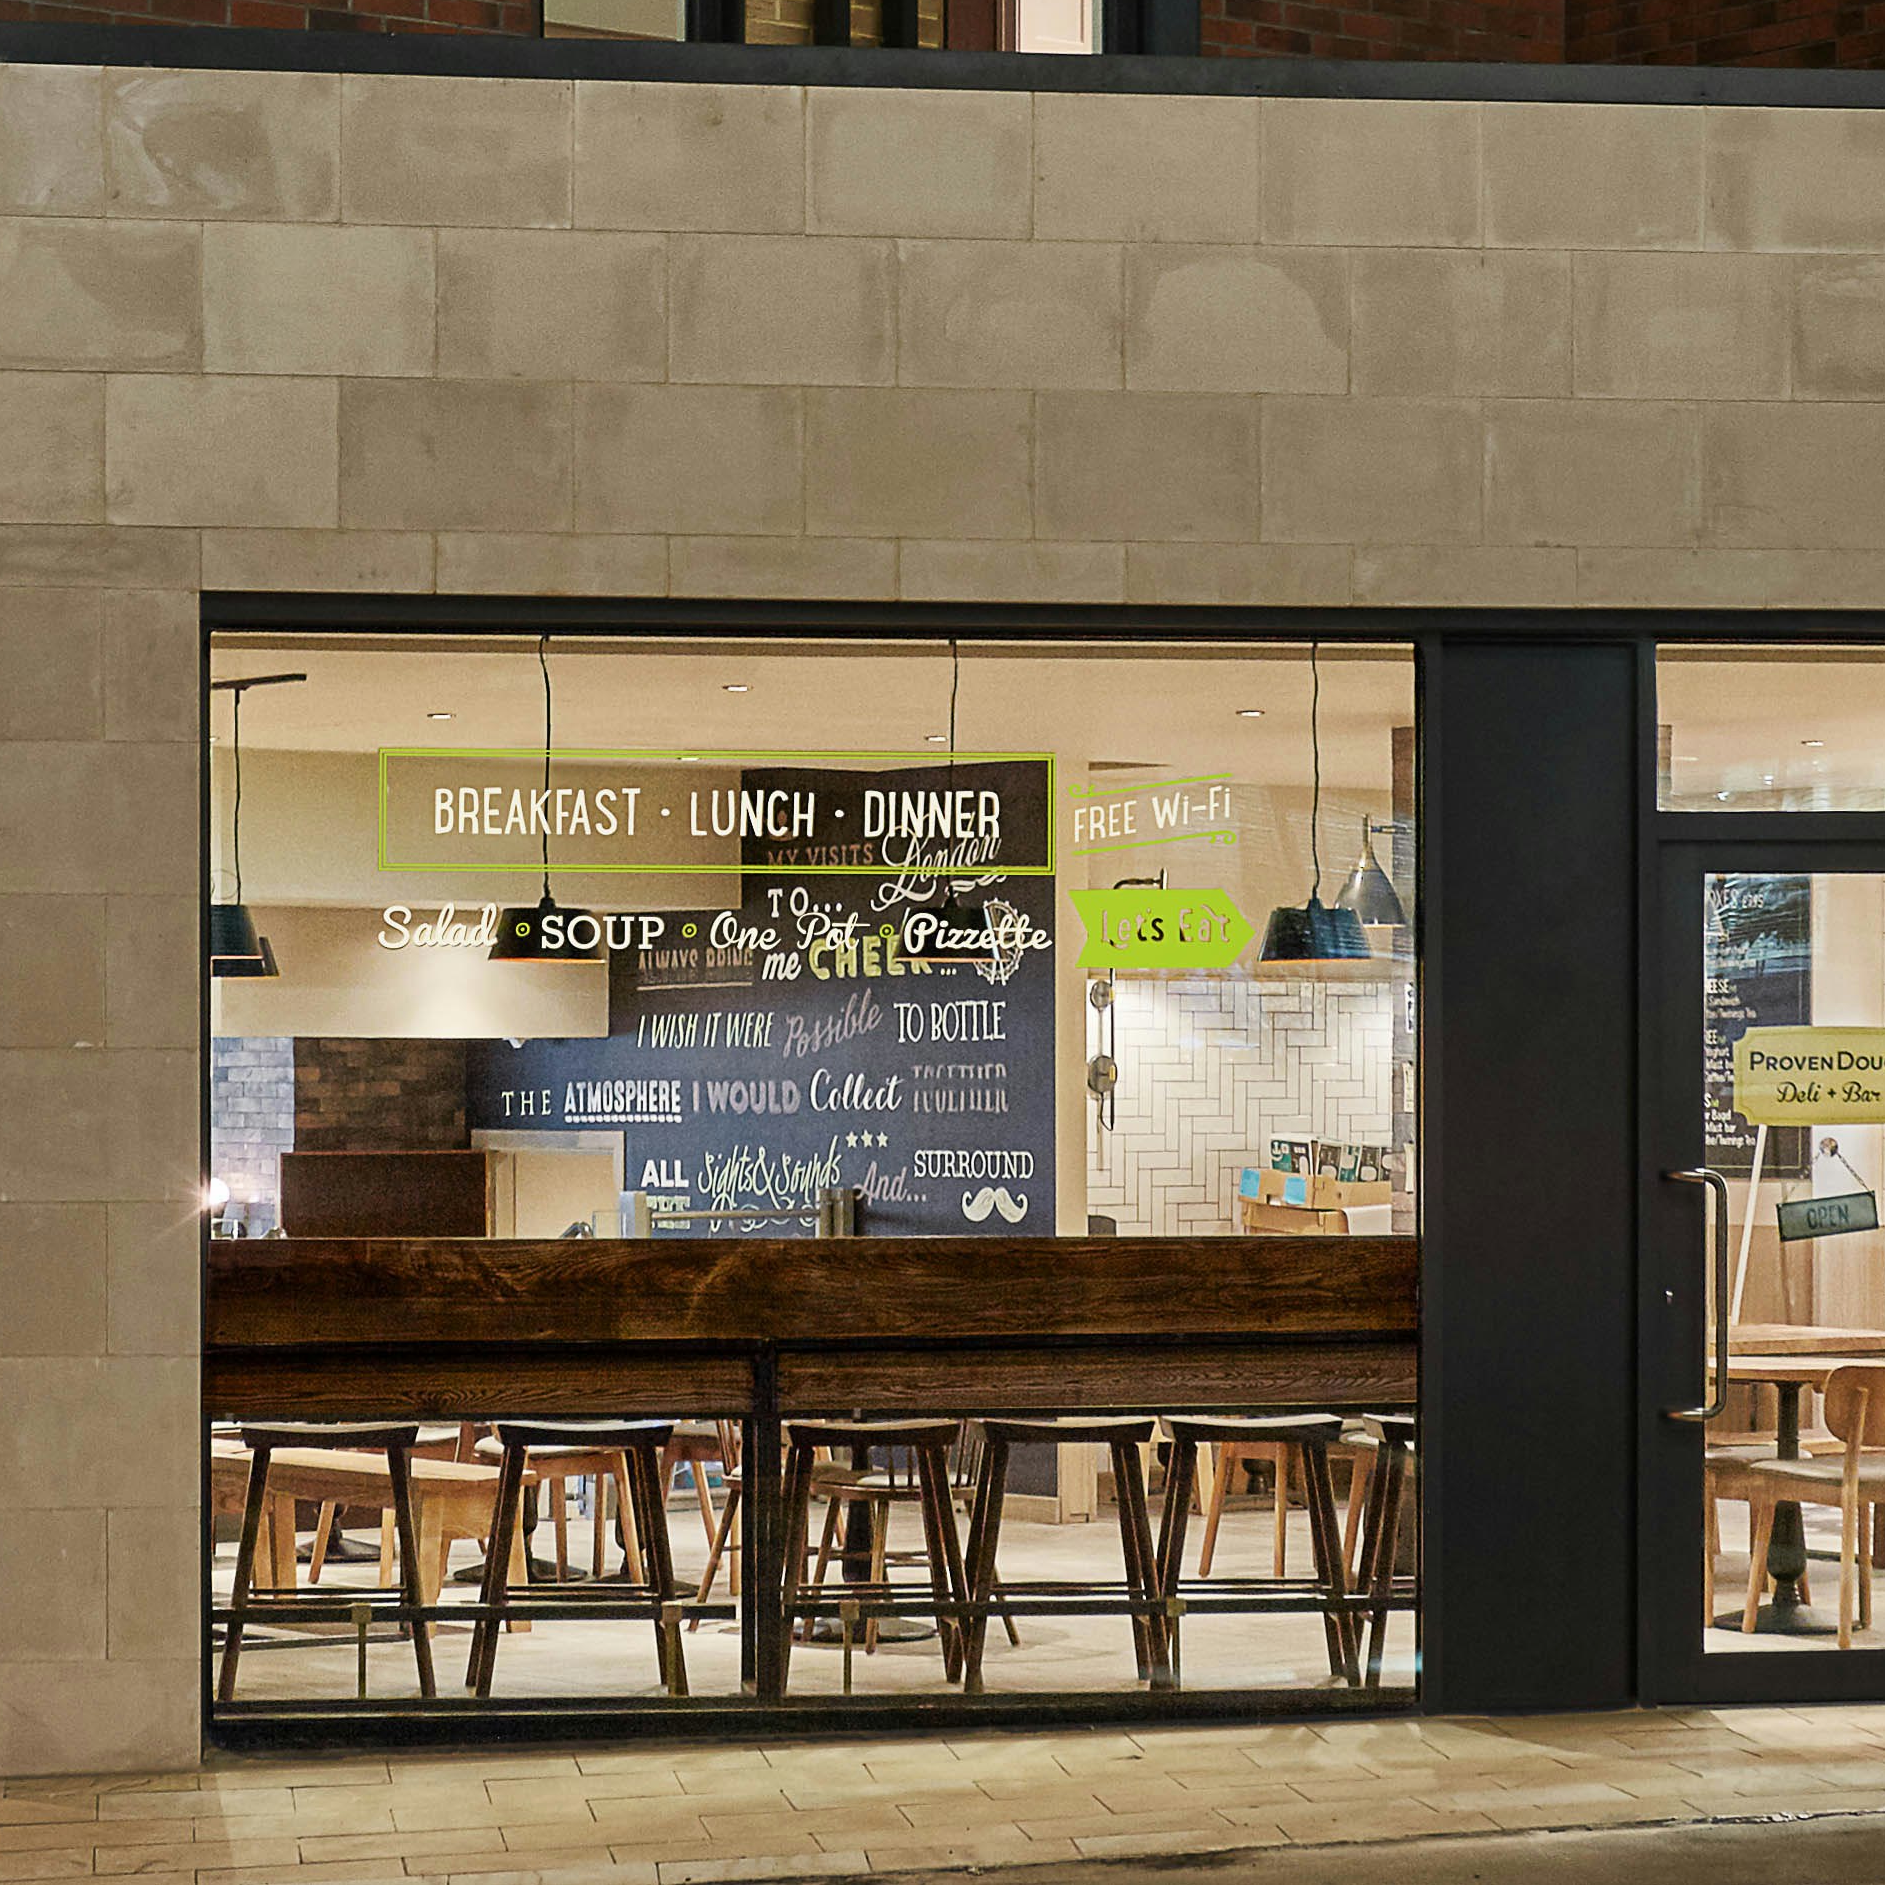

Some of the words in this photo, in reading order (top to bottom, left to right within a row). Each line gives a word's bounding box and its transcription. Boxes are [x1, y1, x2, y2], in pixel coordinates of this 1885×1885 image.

[434, 787, 641, 836] BREAKFAST
[690, 790, 815, 837] LUNCH
[865, 790, 1000, 838] DINNER
[1073, 800, 1138, 843] FREE
[1151, 785, 1231, 829] Wi-Fi
[768, 850, 797, 866] MY
[806, 843, 874, 866] VISITS
[870, 812, 1002, 912] London
[378, 902, 499, 950] Salad
[541, 915, 665, 950] SOUP
[710, 911, 781, 950] One
[796, 911, 870, 951] Pot
[901, 912, 1053, 954] Pizzette
[1101, 908, 1164, 950] Let's
[1179, 904, 1230, 943] Eat
[762, 952, 801, 981] me
[637, 1014, 646, 1048] I
[651, 1013, 699, 1048] WISH
[703, 1013, 720, 1048] IT
[726, 1011, 774, 1048] WERE
[782, 987, 884, 1058] Possible
[893, 1001, 924, 1043] TO
[930, 1000, 1006, 1042] BOTTLE
[501, 1089, 552, 1116] THE
[564, 1079, 682, 1113] ATMOSPHERE
[692, 1080, 700, 1113] I
[706, 1079, 801, 1115] WOULD
[809, 1067, 905, 1112] Collect
[1776, 1081, 1822, 1104] Deli
[1842, 1081, 1881, 1104] Bar
[641, 1159, 690, 1188] ALL
[913, 1149, 1034, 1180] SURROUND
[1806, 1204, 1850, 1230] OPEN
